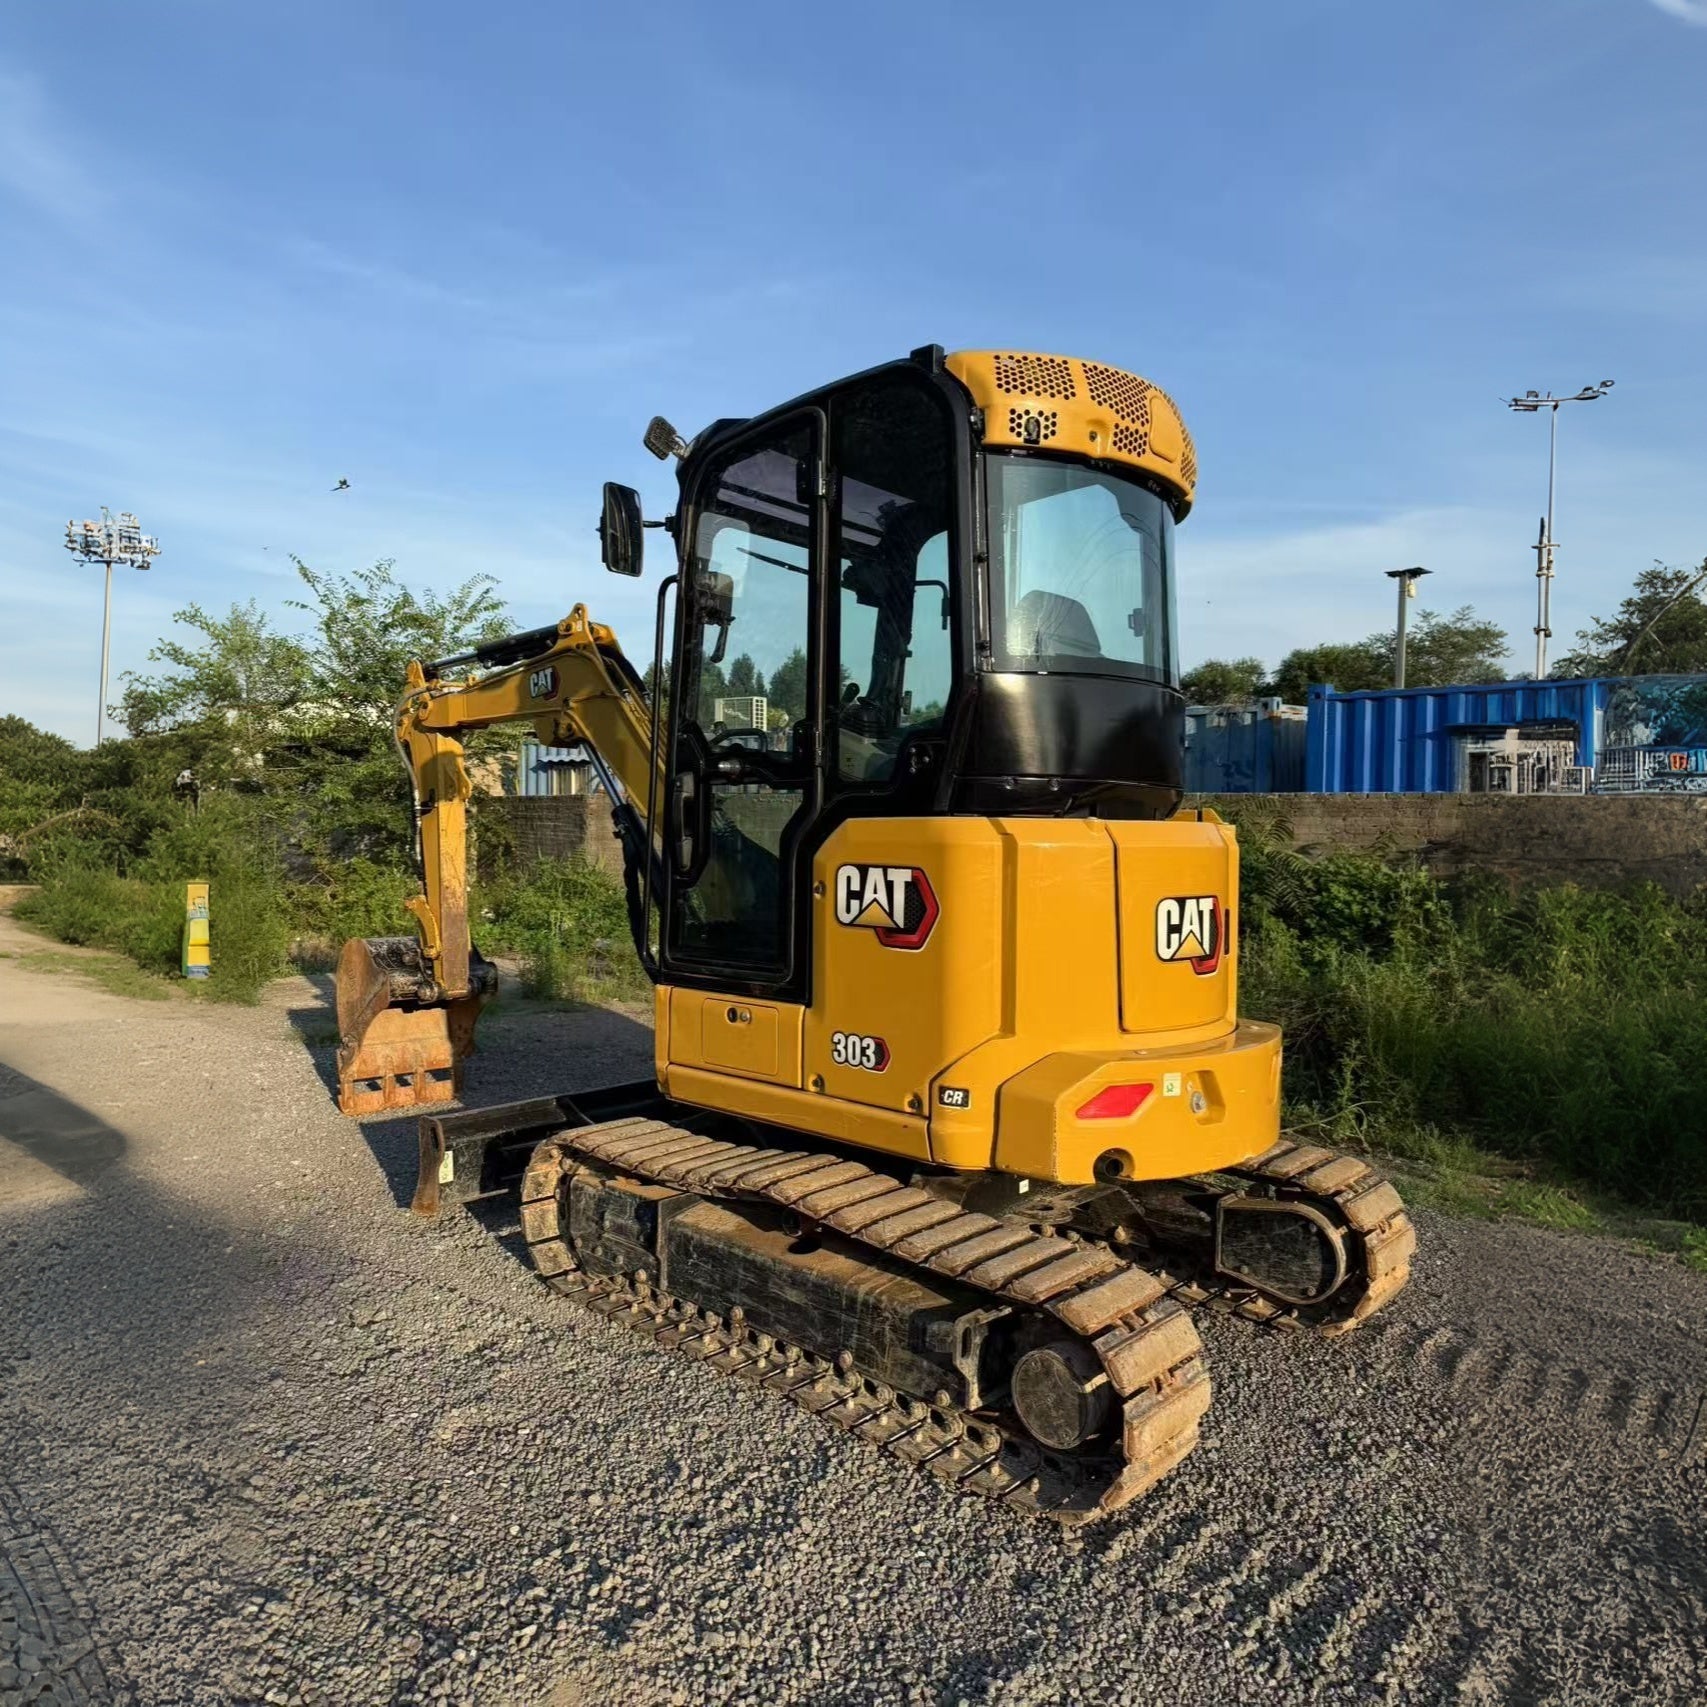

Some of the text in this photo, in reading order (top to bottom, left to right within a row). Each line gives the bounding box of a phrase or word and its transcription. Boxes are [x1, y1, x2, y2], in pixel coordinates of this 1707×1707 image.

[530, 667, 552, 697] CAT
[837, 865, 912, 929] CAT
[1157, 897, 1214, 960] CAT
[832, 1032, 876, 1069] 303
[943, 1089, 964, 1105] CR
